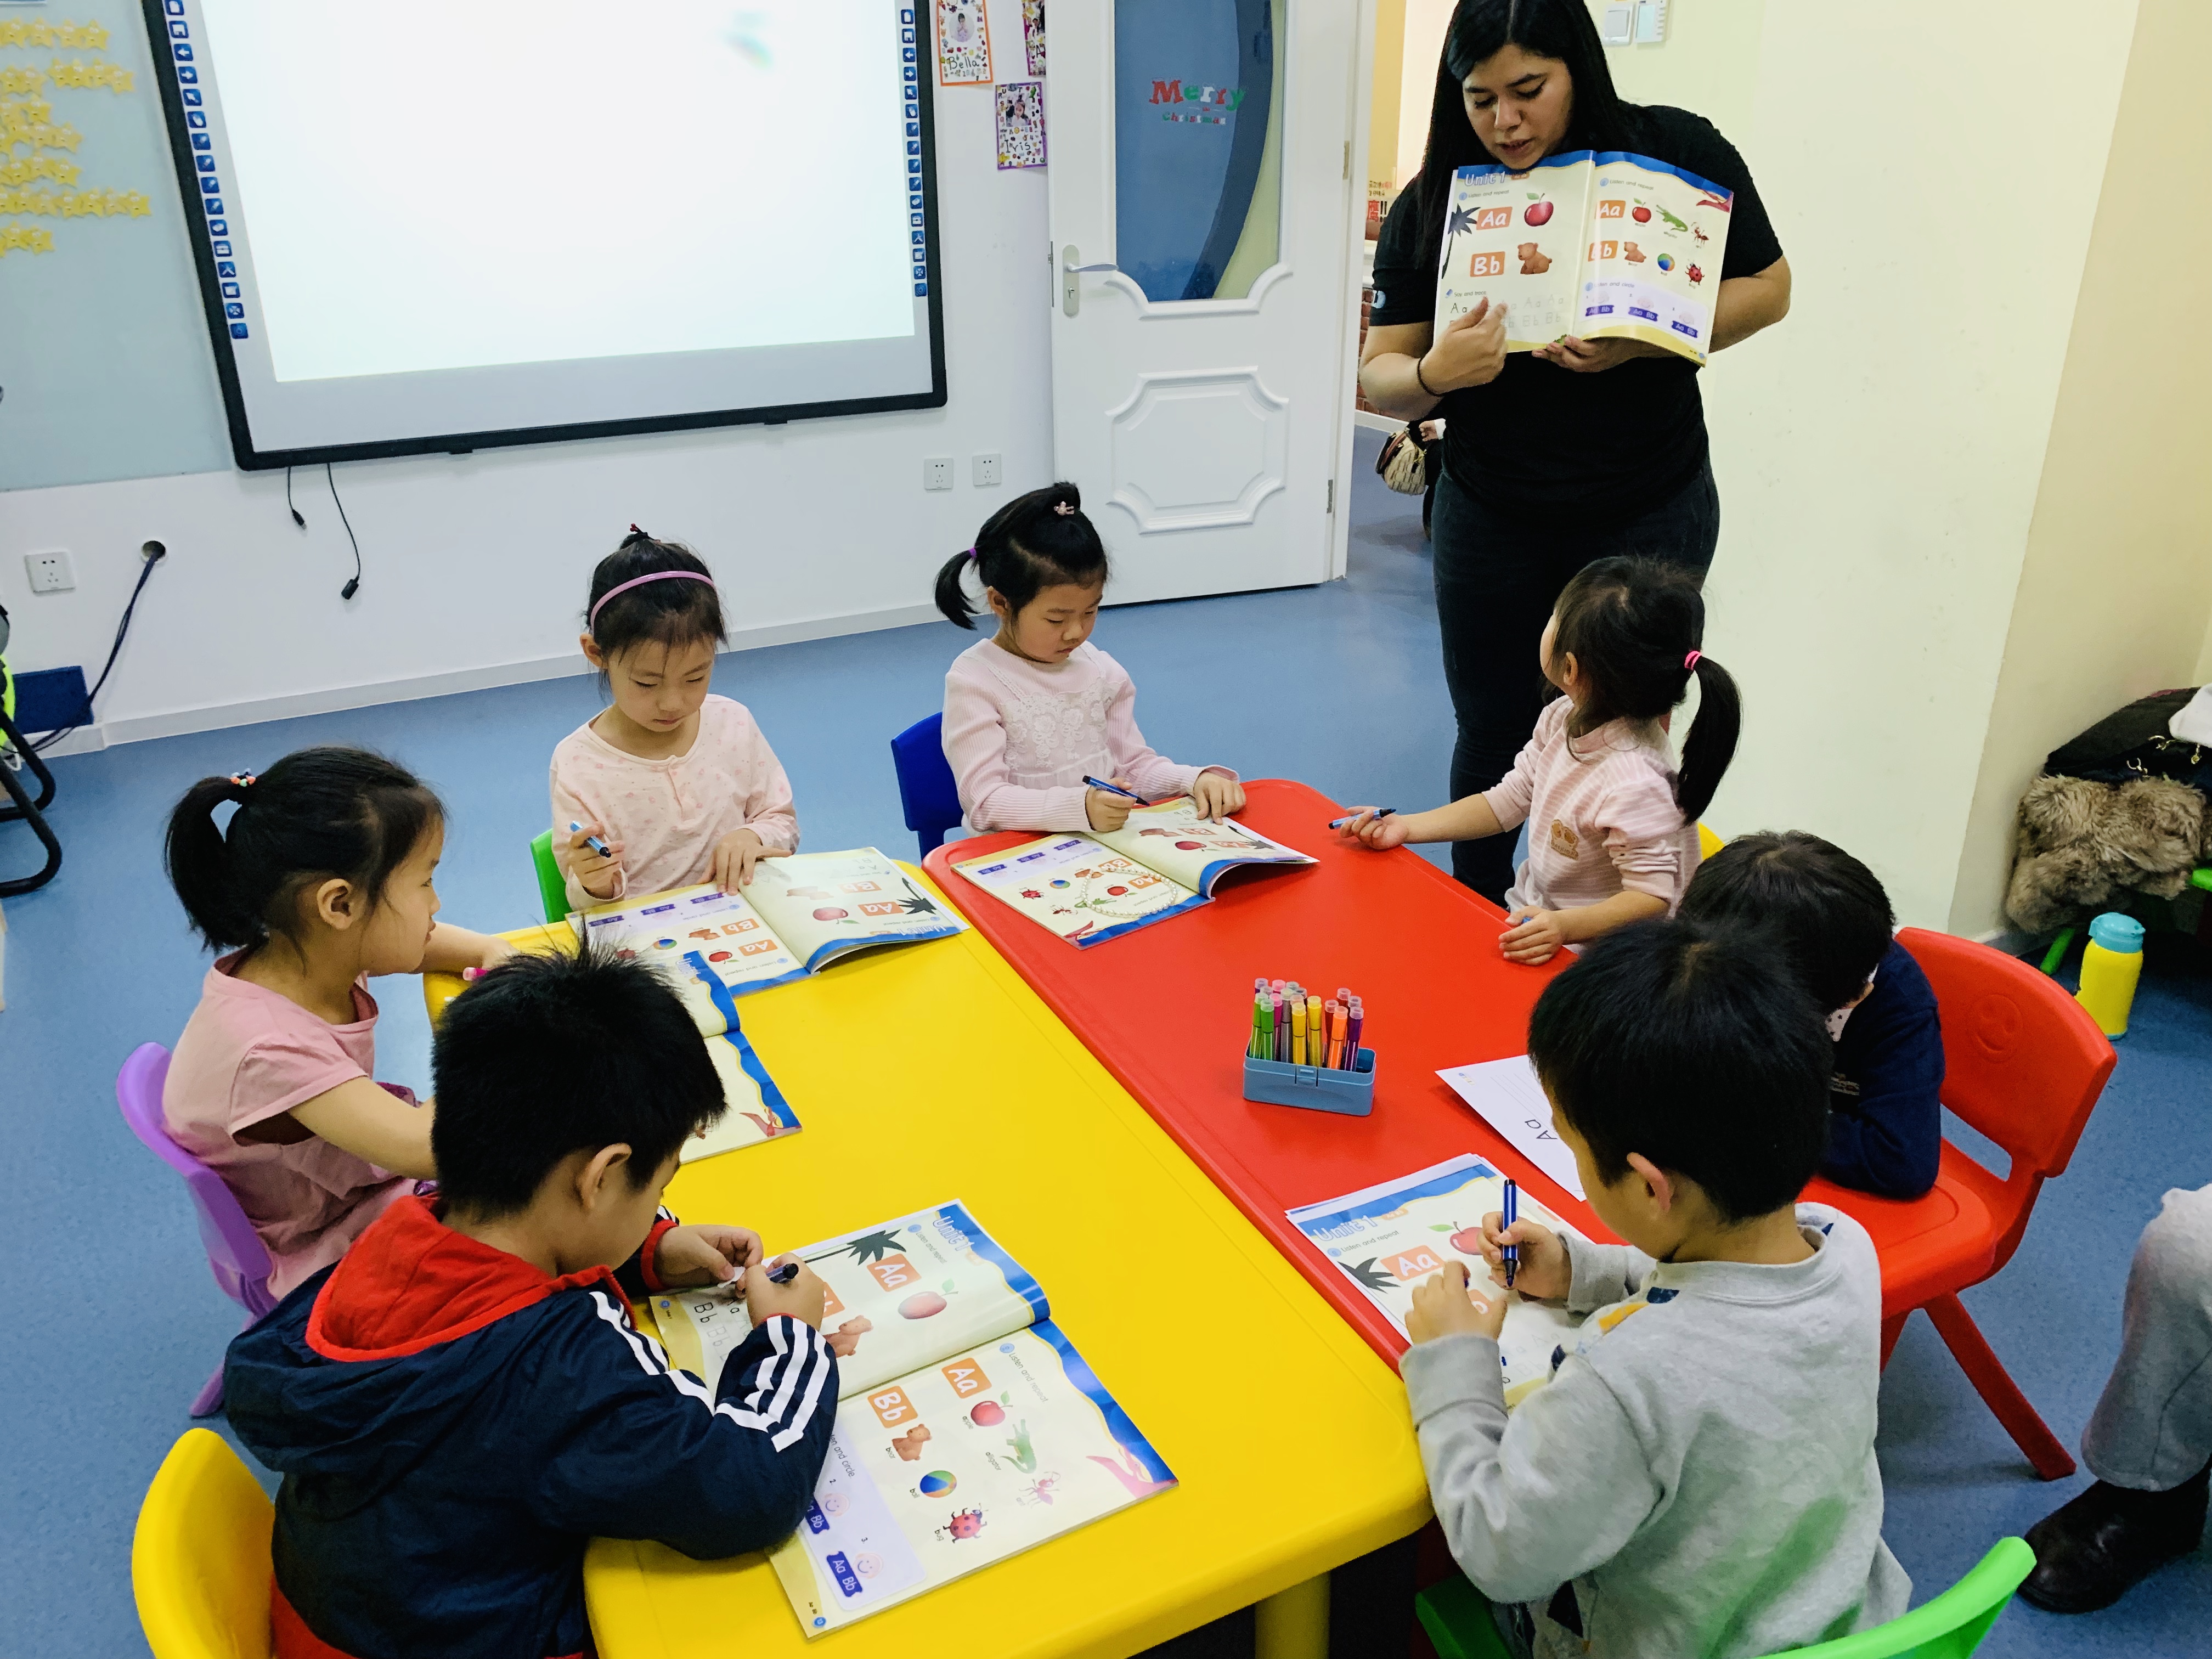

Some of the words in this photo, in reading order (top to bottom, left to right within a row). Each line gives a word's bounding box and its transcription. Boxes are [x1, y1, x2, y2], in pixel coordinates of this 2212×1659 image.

[948, 57, 979, 70] Bella
[1149, 80, 1246, 111] Merry
[1005, 139, 1030, 153] Iris
[1465, 173, 1496, 187] Unit
[1500, 171, 1505, 183] 1
[1600, 203, 1621, 216] Aa
[1481, 211, 1507, 227] Aa
[1474, 256, 1500, 275] Bb
[843, 882, 876, 891] Bb
[1132, 877, 1154, 885] Aa
[864, 903, 893, 913] Aa
[727, 920, 754, 932] Bb
[907, 924, 947, 934] Unit
[743, 941, 768, 952] Aa
[933, 1216, 968, 1245] Unit
[955, 1242, 975, 1251] 1
[1313, 1219, 1365, 1242] Unit
[1362, 1215, 1378, 1228] 1
[916, 1232, 930, 1245] Listen
[926, 1243, 936, 1252] and
[933, 1250, 947, 1265] repeat
[1341, 1243, 1362, 1252] Listen
[1362, 1238, 1376, 1246] and
[1377, 1230, 1400, 1242] repeat
[1398, 1253, 1440, 1277] Aa
[874, 1263, 907, 1288] Aa
[948, 1368, 978, 1393] Aa
[1009, 1353, 1024, 1369] Listen
[1022, 1369, 1035, 1382] and
[1030, 1382, 1048, 1403] repeat
[874, 1392, 907, 1421] Bb
[962, 1415, 974, 1430] apple
[834, 1447, 848, 1459] and
[885, 1447, 896, 1459] bear
[985, 1452, 1002, 1471] alligator
[910, 1488, 920, 1499] ball
[1016, 1497, 1025, 1507] ant
[811, 1514, 825, 1528] Bb
[934, 1529, 944, 1542] bug
[833, 1559, 846, 1573] Aa
[842, 1576, 856, 1591] Bb
